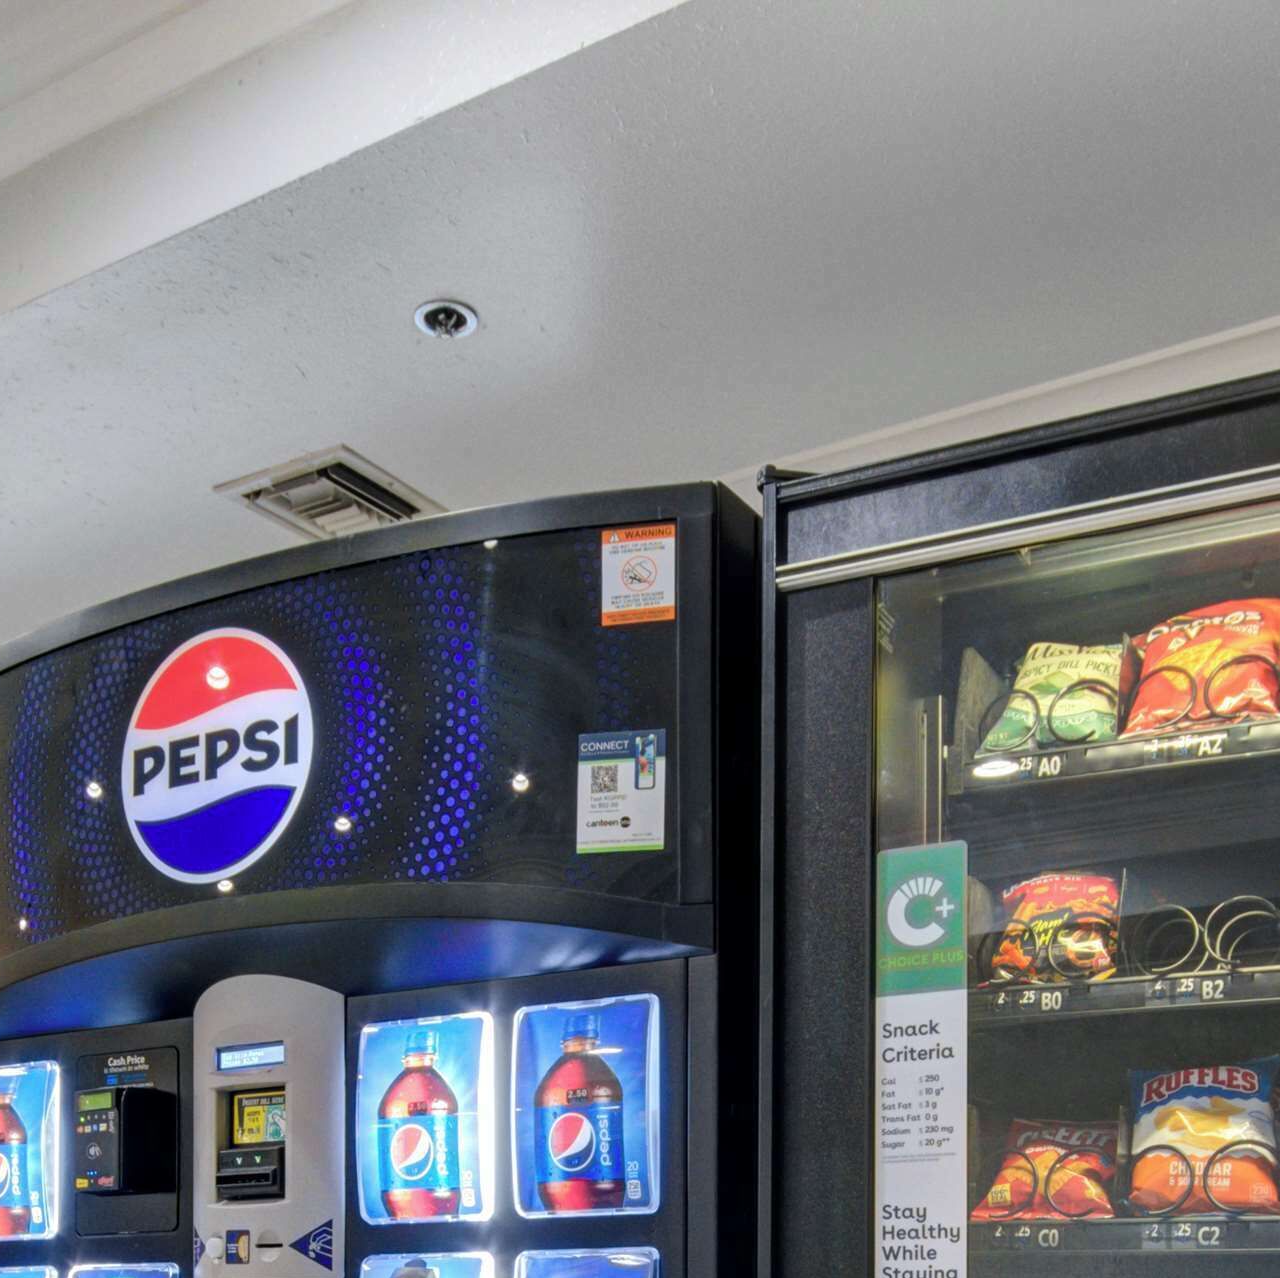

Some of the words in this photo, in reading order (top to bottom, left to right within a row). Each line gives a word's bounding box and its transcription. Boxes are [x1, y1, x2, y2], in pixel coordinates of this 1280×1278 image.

[624, 528, 672, 538] WARNING
[581, 740, 629, 752] CONNECT
[132, 714, 298, 797] PEPSI
[1038, 755, 1061, 776] A0
[586, 819, 619, 827] canteen
[879, 951, 929, 969] CHOICE
[933, 950, 965, 963] PLUS
[1202, 980, 1224, 999] B2
[1041, 992, 1061, 1010] B0
[882, 1020, 940, 1039] Snack
[108, 1056, 125, 1066] Cash
[127, 1055, 145, 1064] Price
[882, 1043, 954, 1063] Criteria
[881, 1077, 896, 1086] Cal
[925, 1074, 939, 1082] 250
[1141, 1066, 1259, 1107] RUFFLES
[568, 1089, 587, 1098] 2.50
[881, 1090, 895, 1098] Fat
[882, 1115, 904, 1123] Trans
[881, 1127, 910, 1136] Sodium
[941, 1125, 954, 1134] mg
[596, 1115, 612, 1166] pepsi
[881, 1141, 905, 1150] Sugar
[627, 1161, 639, 1171] 20
[882, 1204, 927, 1223] Stay
[882, 1224, 960, 1243] Healthy
[1197, 1226, 1219, 1245] C2
[882, 1245, 937, 1261] While
